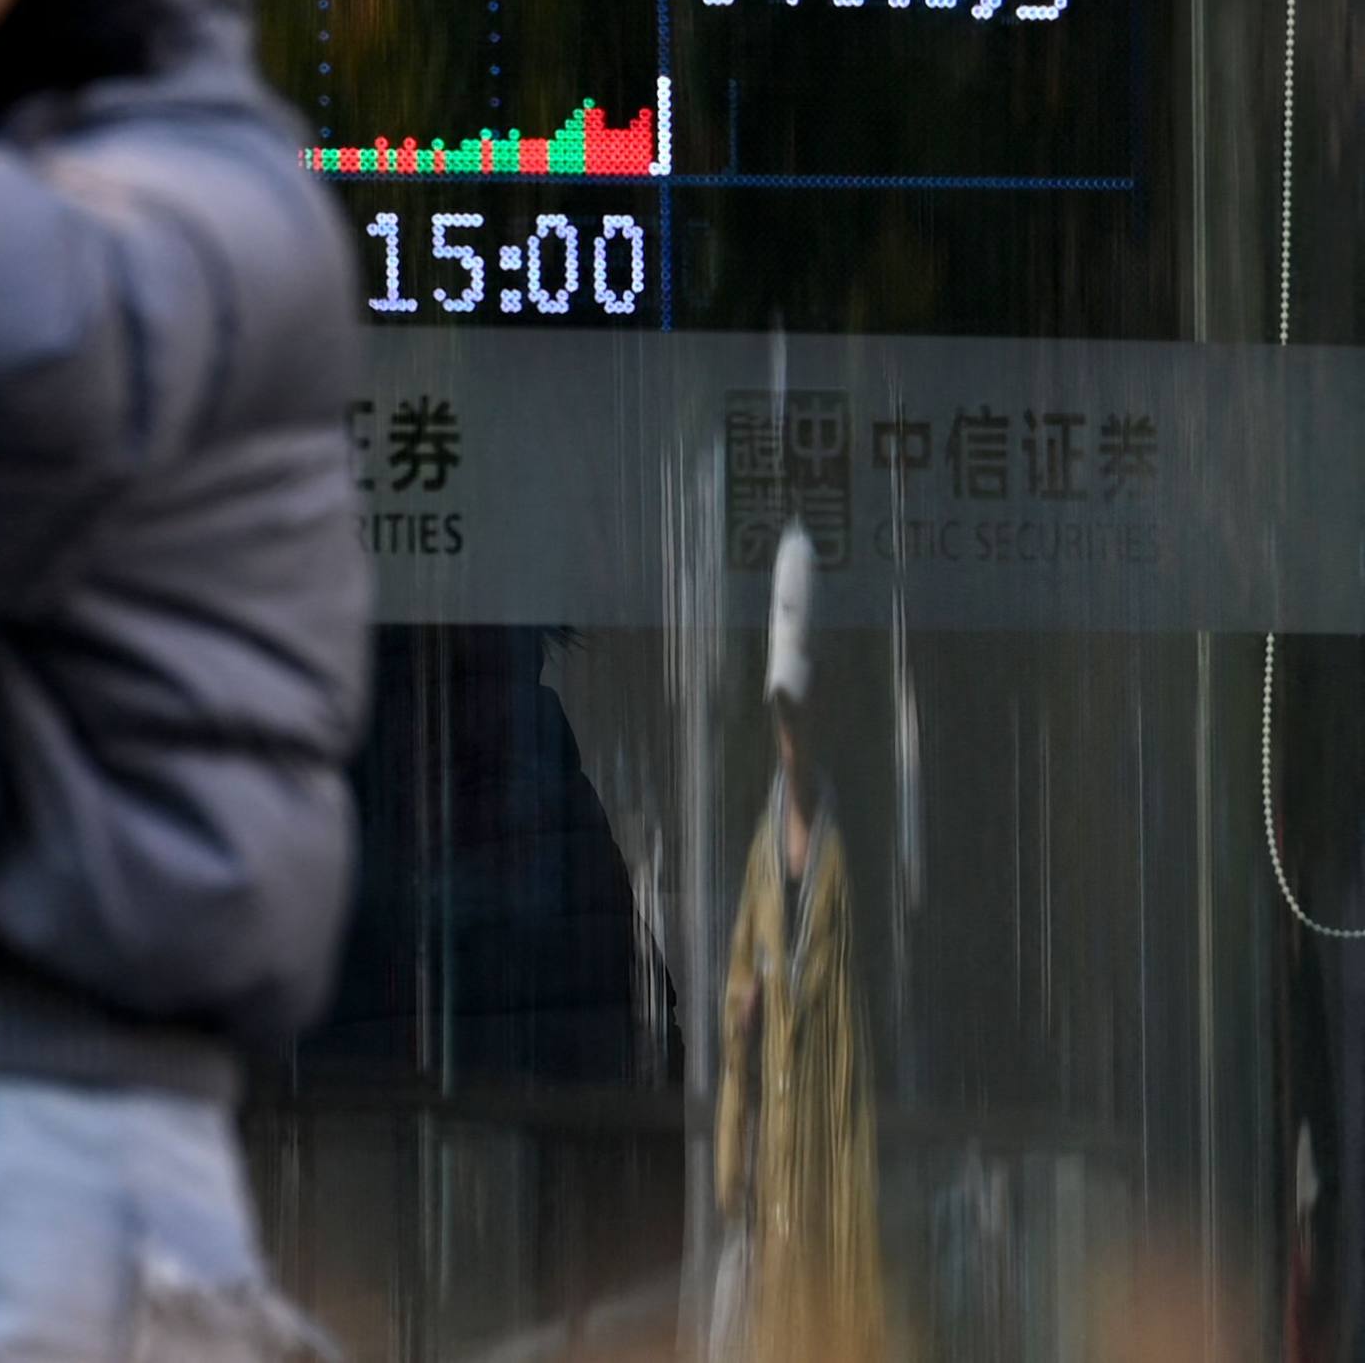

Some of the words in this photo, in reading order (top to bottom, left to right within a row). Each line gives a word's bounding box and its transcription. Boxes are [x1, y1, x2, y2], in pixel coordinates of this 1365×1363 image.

[366, 211, 645, 314] 15:00
[871, 403, 1159, 504] 中信证券
[974, 518, 1159, 565] SECURITIES
